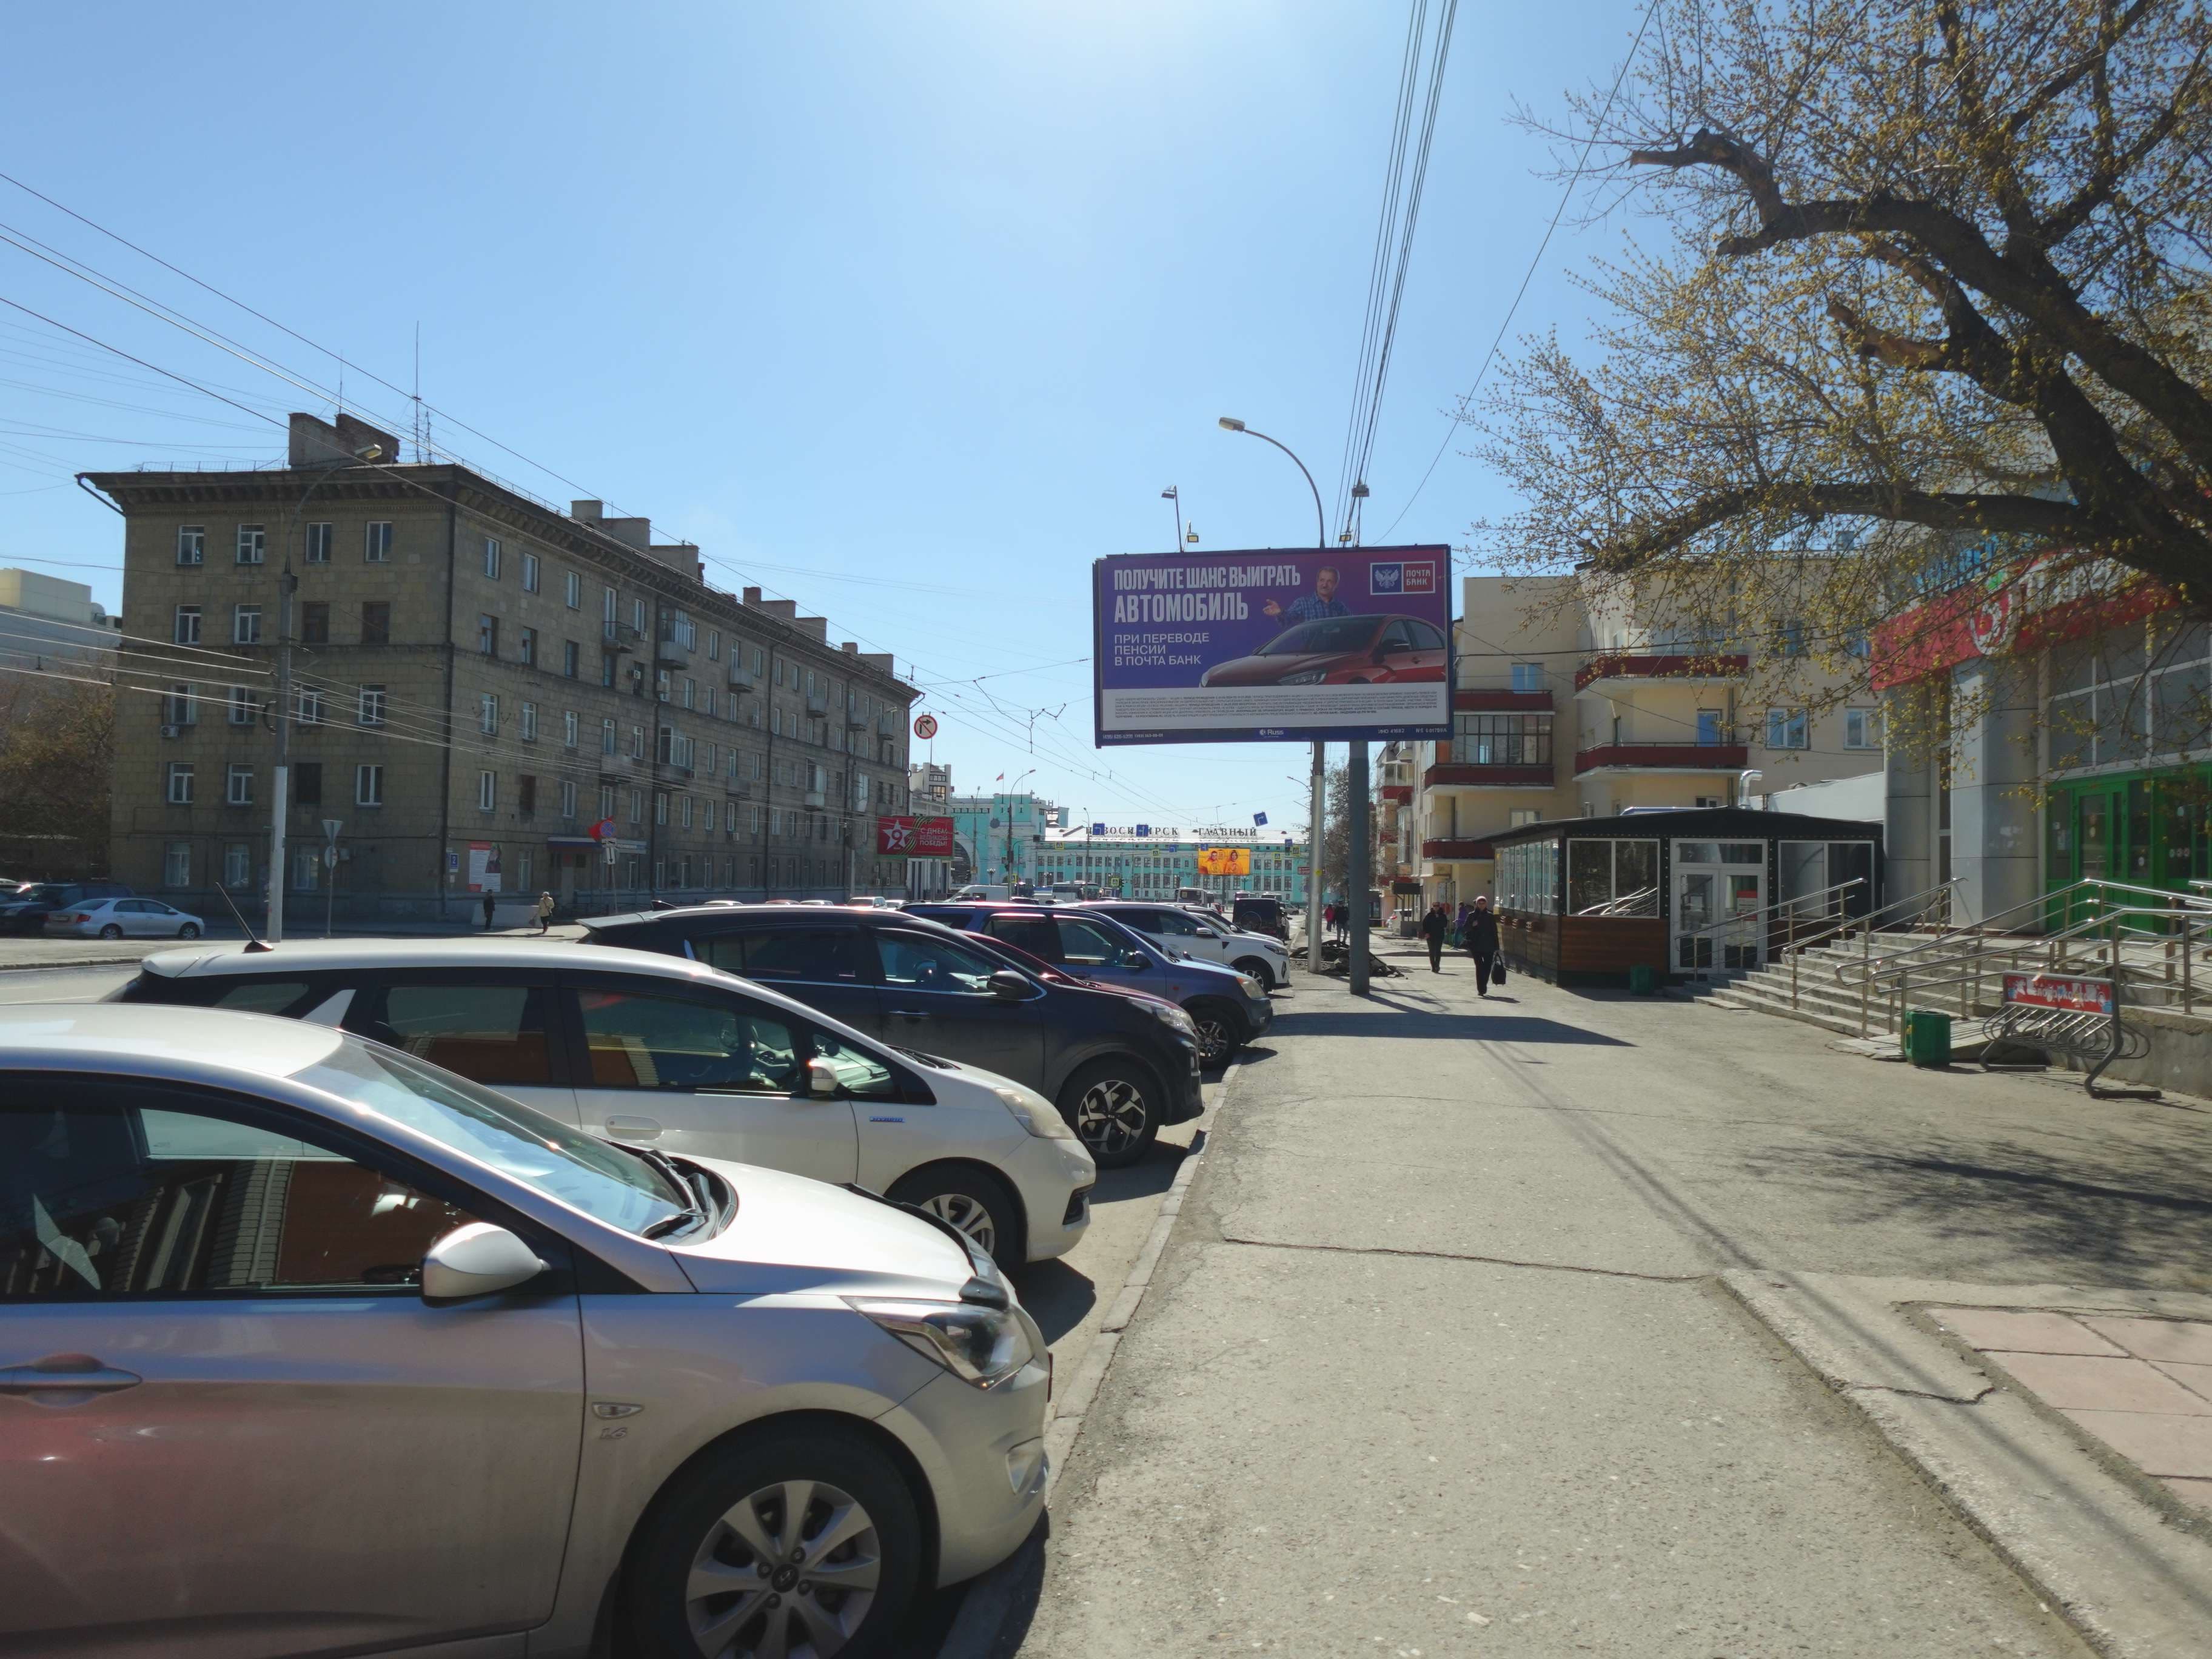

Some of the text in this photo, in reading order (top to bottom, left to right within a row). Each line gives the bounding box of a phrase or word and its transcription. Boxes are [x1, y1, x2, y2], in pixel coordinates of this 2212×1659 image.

[1114, 565, 1300, 590] ПОЛУЧИТЕ ШАНС ВЫИГРАТЬ
[1114, 592, 1248, 623] АВТОМОБИЛЬ
[1114, 632, 1210, 644] ПРИ ПЕРЕВОДЕ
[1114, 645, 1166, 655] ПЕНСИИ
[1114, 654, 1201, 666] В ПОЧТА БАНК
[891, 829, 903, 846] 9
[1199, 827, 1257, 836] ГЛАВНЫЙ
